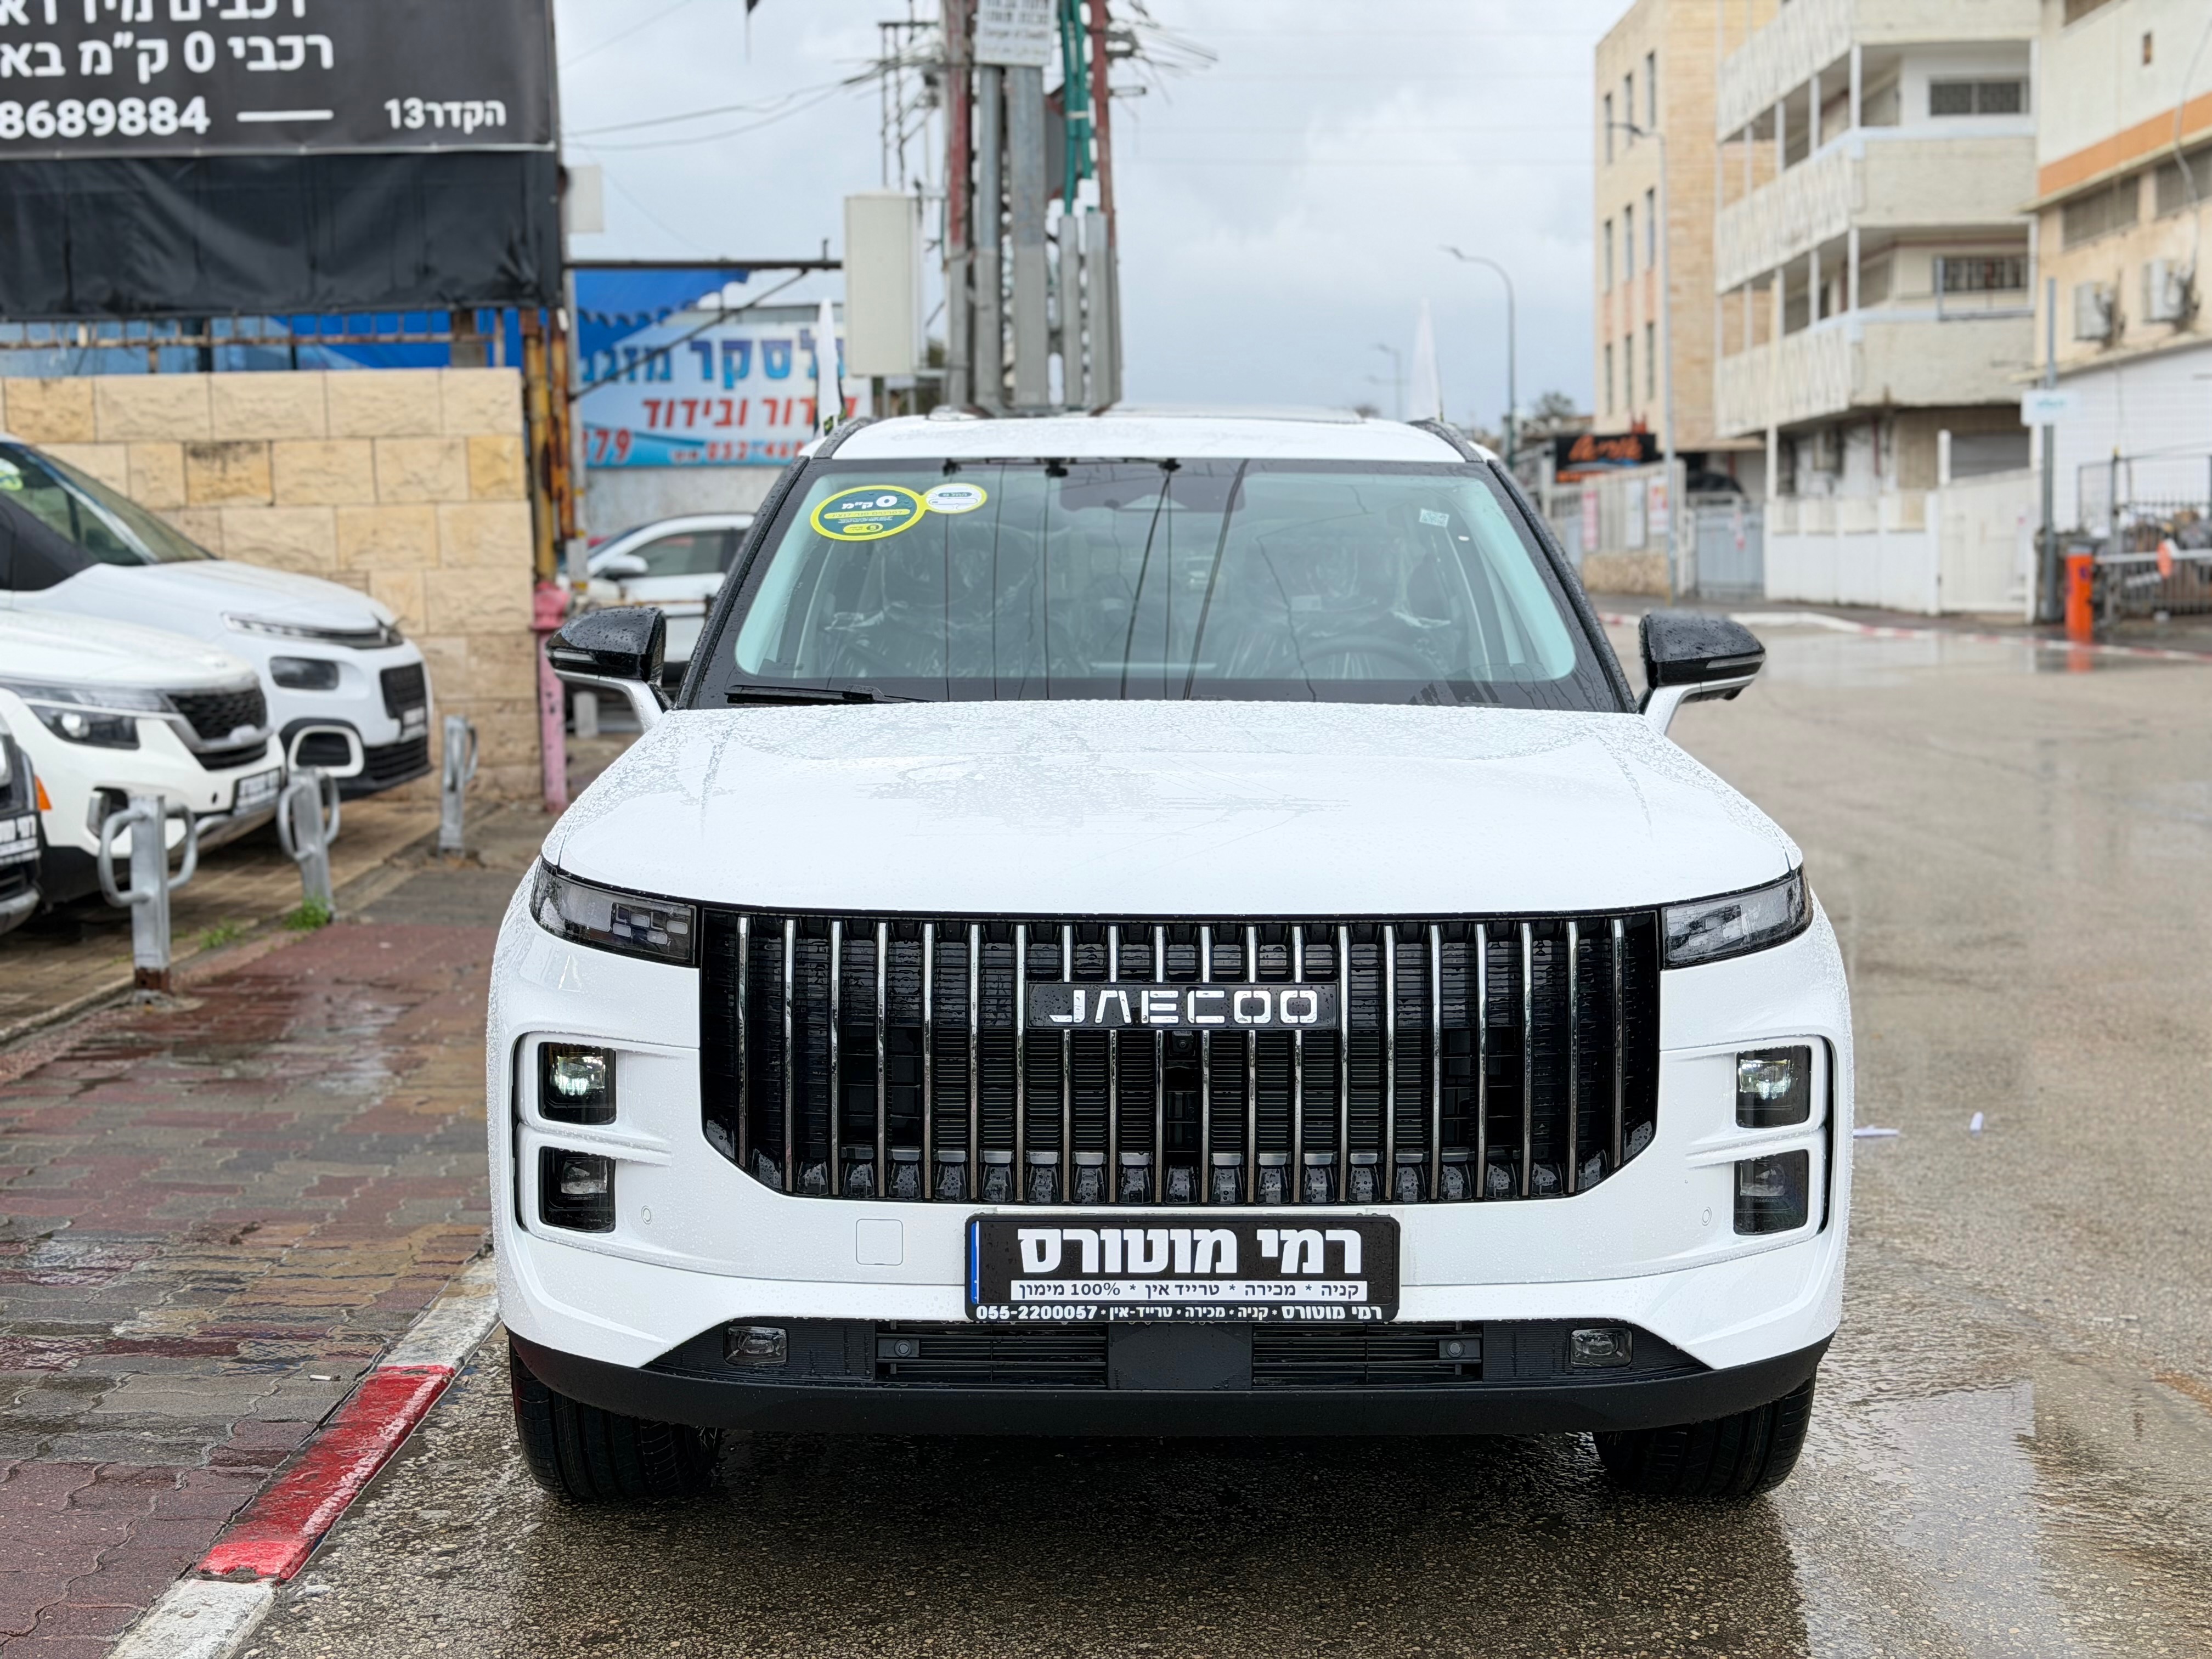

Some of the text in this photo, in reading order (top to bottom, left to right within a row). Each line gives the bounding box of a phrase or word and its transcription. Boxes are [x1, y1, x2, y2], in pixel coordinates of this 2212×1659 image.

[183, 30, 216, 74] 0
[227, 34, 334, 71] רכבי
[0, 95, 211, 139] 8689884
[642, 398, 748, 428] ובידוד
[876, 495, 898, 507] 0
[1048, 989, 1318, 1024] JAECOO
[1017, 1228, 1362, 1274] רמי מוטורס
[1019, 1282, 1358, 1300] קניה מכירה טרייד אין 100% מימון
[976, 1305, 1383, 1321] רמי מוטורס קניה מכירה טרייד-אין 055-2200057
